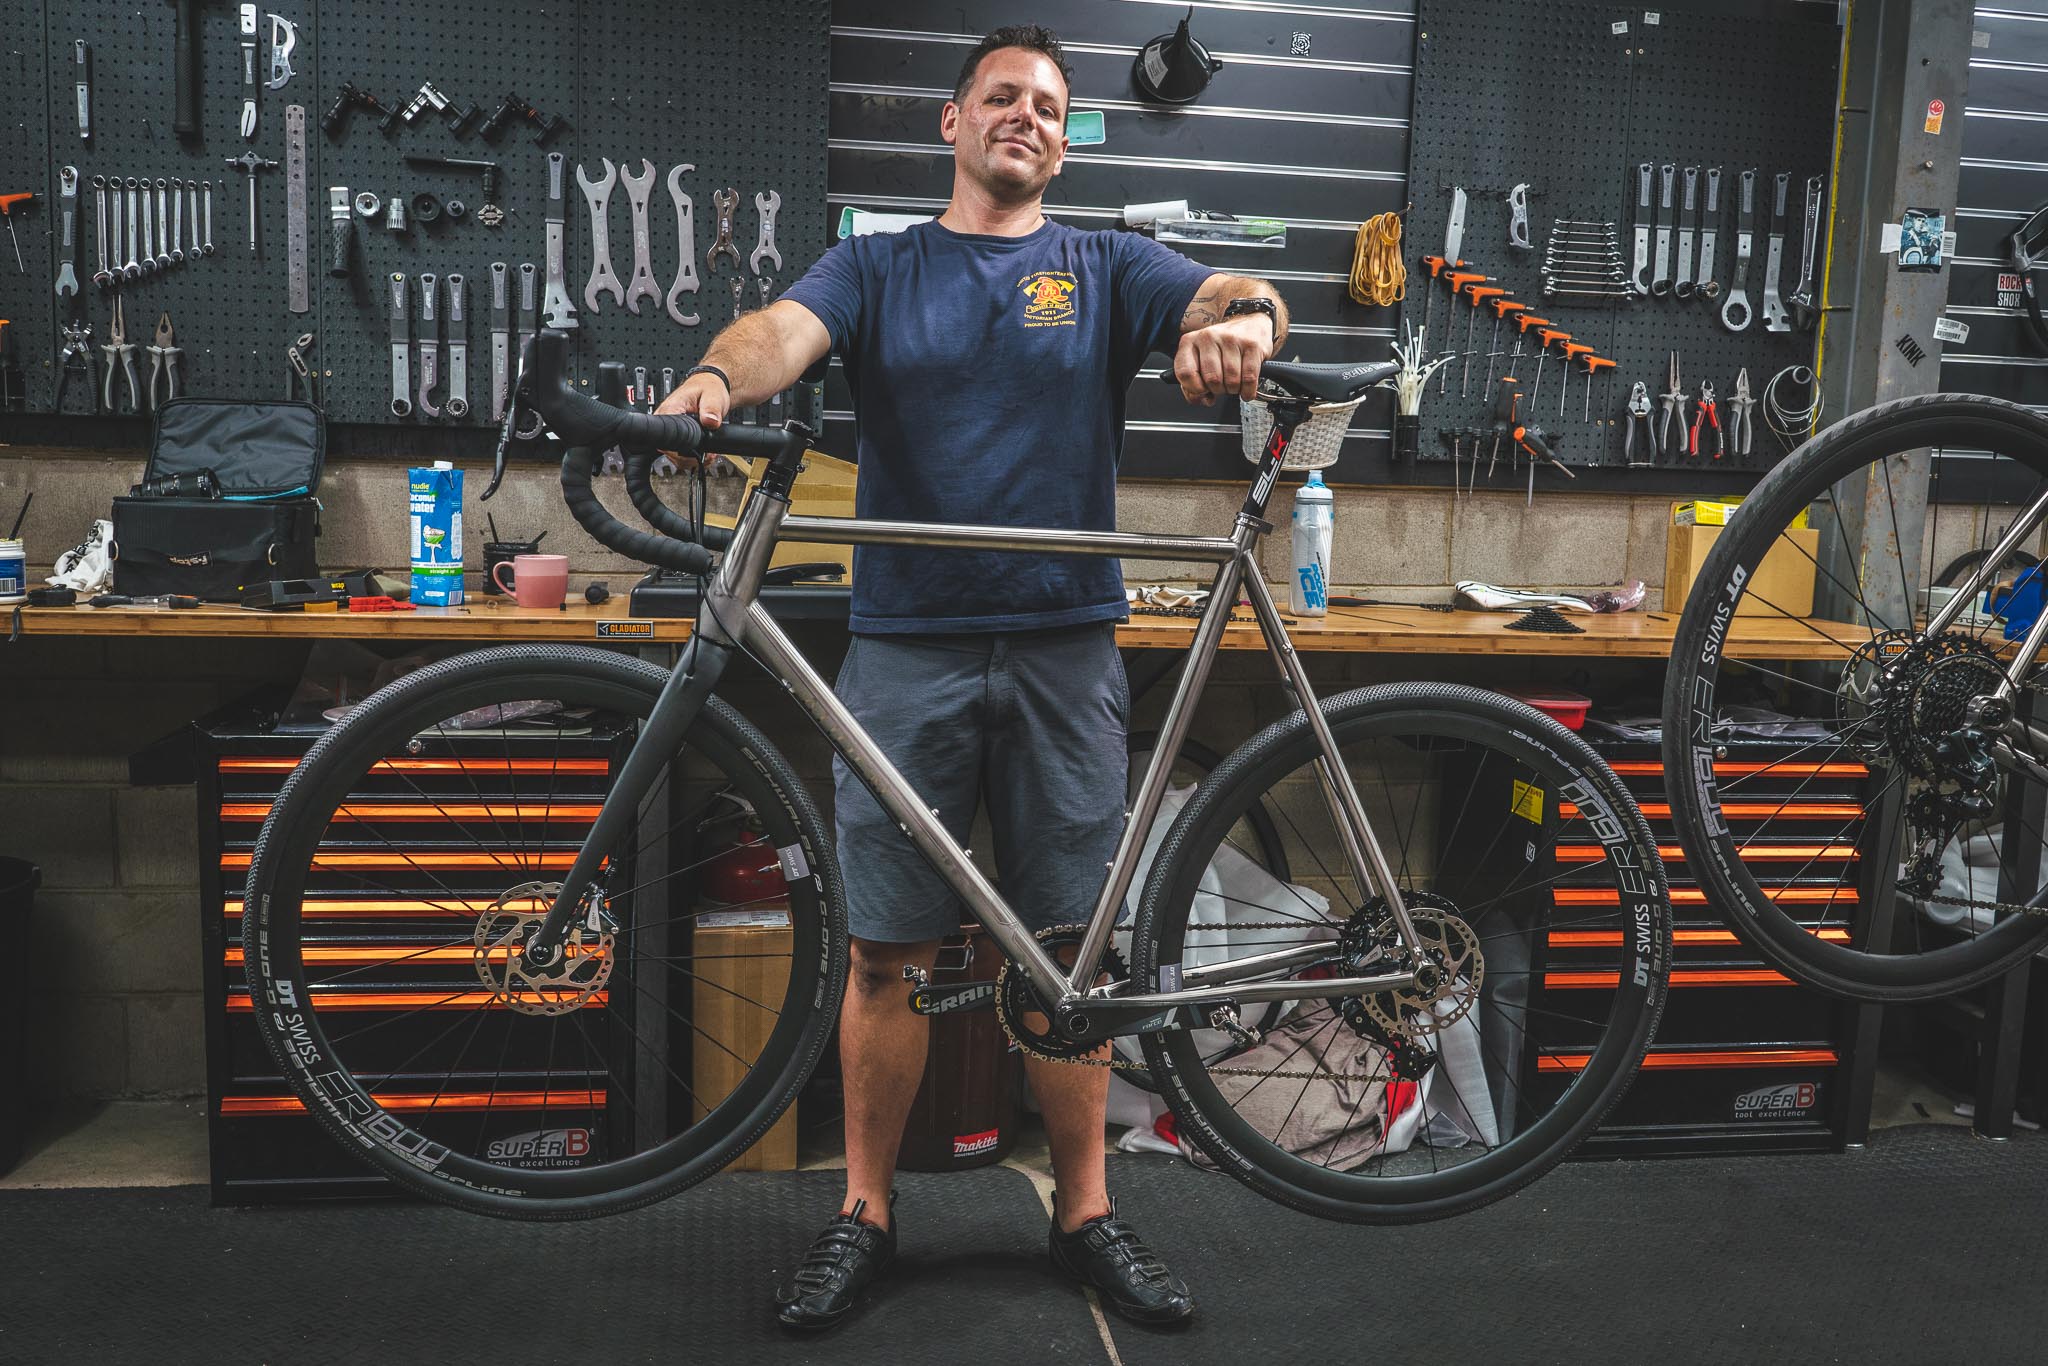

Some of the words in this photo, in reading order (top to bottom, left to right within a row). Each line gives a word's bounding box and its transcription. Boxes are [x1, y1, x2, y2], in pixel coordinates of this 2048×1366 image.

[1997, 292, 2021, 307] SHOX
[1895, 334, 1927, 369] KINK
[410, 492, 436, 503] oconut
[411, 482, 430, 490] nudie
[1298, 567, 1321, 609] ICE
[1725, 563, 1748, 603] DT
[610, 624, 650, 633] GLADIATOR
[1701, 602, 1731, 665] SWISS
[741, 746, 817, 867] SCHWALBE
[1582, 765, 1653, 872] SCHWALBE
[1634, 903, 1651, 954] SWISS
[1633, 957, 1650, 988] DT
[275, 980, 299, 1009] DT
[285, 1013, 322, 1066] SWISS
[283, 1038, 376, 1149] SCHWALBE
[315, 1070, 372, 1120] ER
[1735, 1111, 1753, 1119] tool
[1758, 1109, 1806, 1118] excellence
[359, 1109, 452, 1165] 1600
[1171, 1073, 1254, 1172] SCHWALBE
[519, 1158, 580, 1168] excellence
